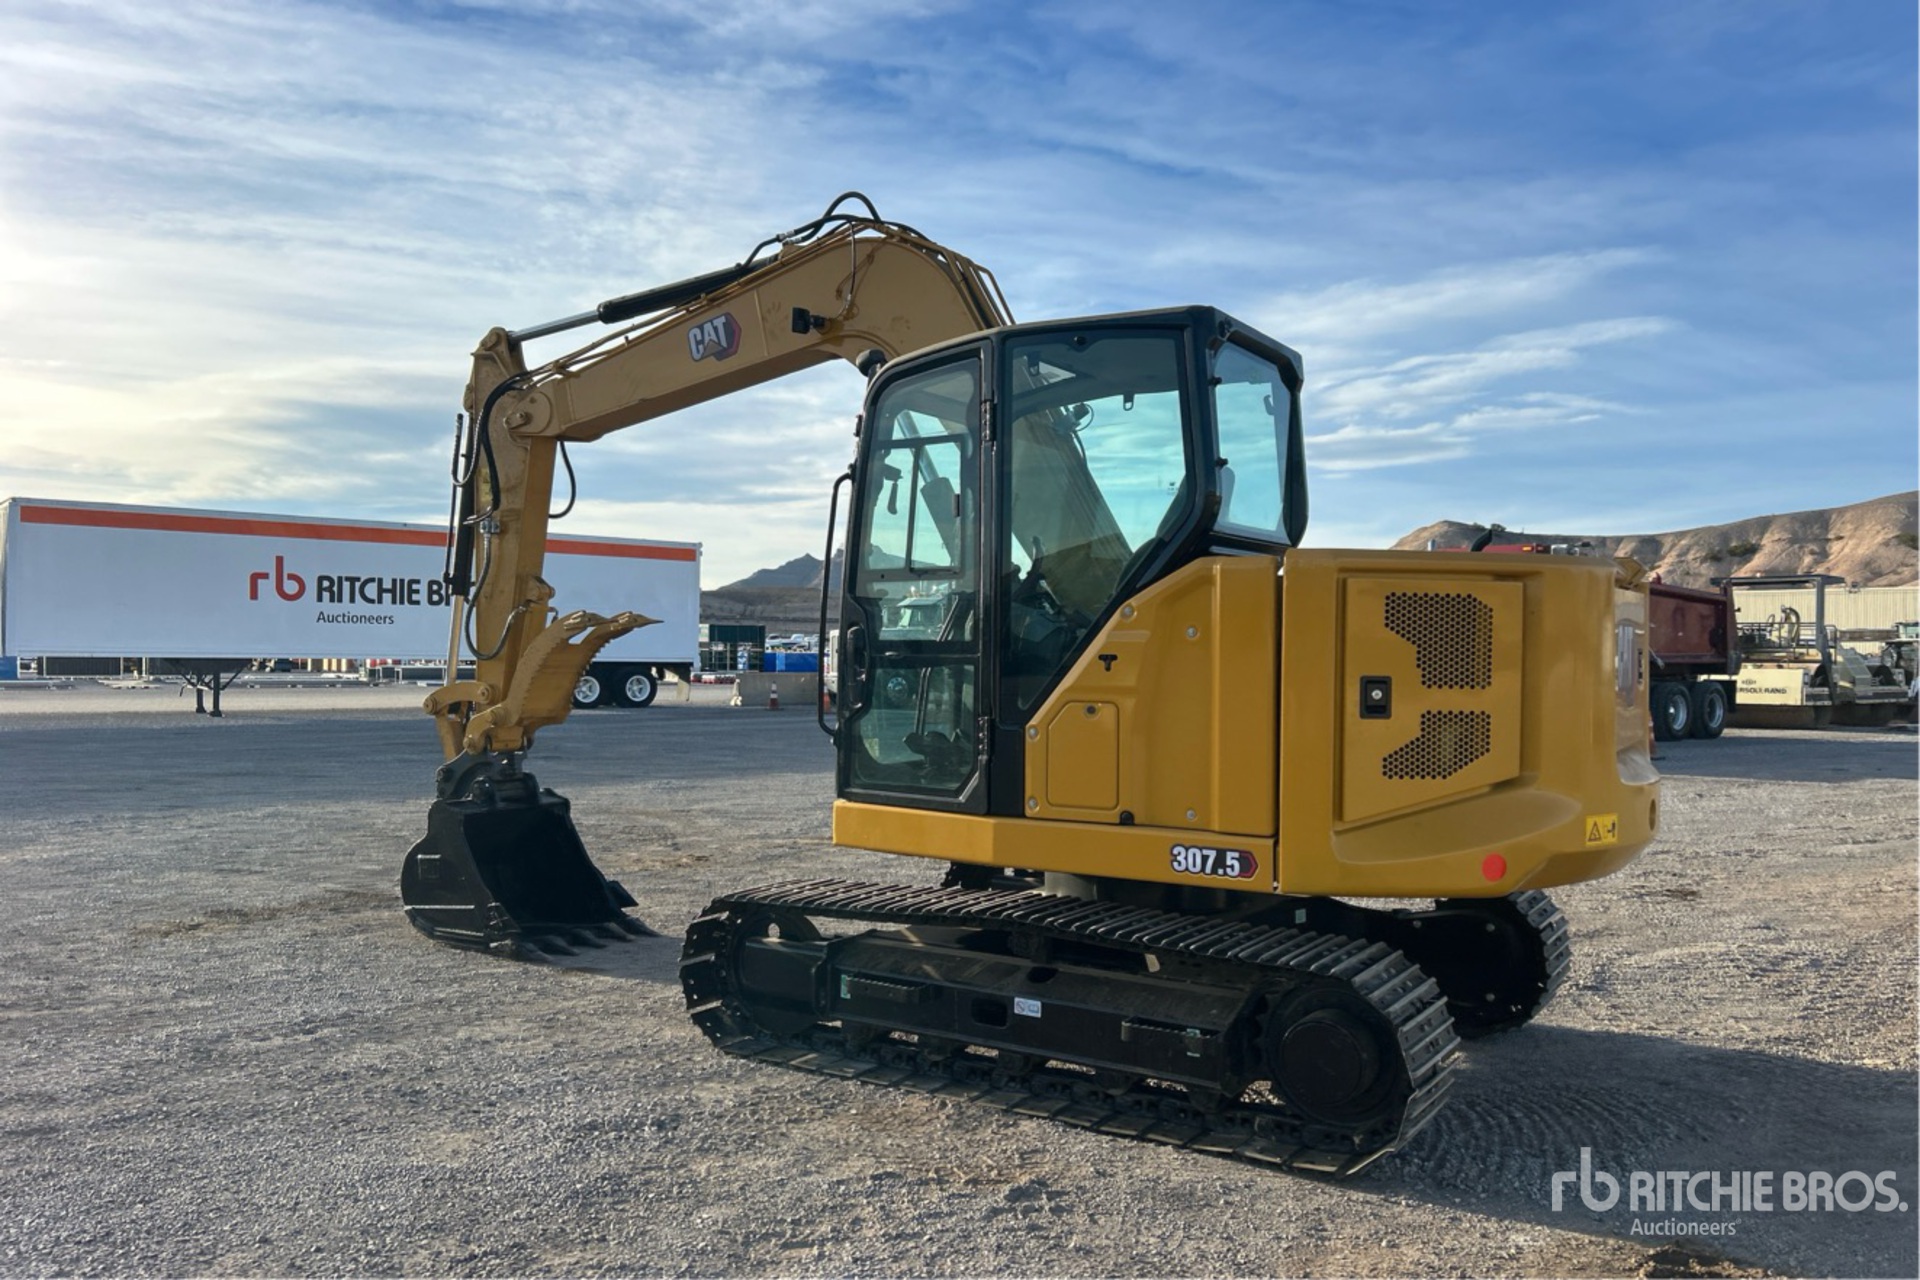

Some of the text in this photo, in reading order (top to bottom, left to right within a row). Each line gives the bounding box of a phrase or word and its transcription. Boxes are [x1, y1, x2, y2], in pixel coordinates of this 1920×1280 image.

[688, 315, 728, 361] CAT
[249, 555, 306, 602] rb
[316, 575, 421, 605] RITCHIE
[316, 610, 395, 625] Auctioneers
[1171, 845, 1241, 878] 307.5
